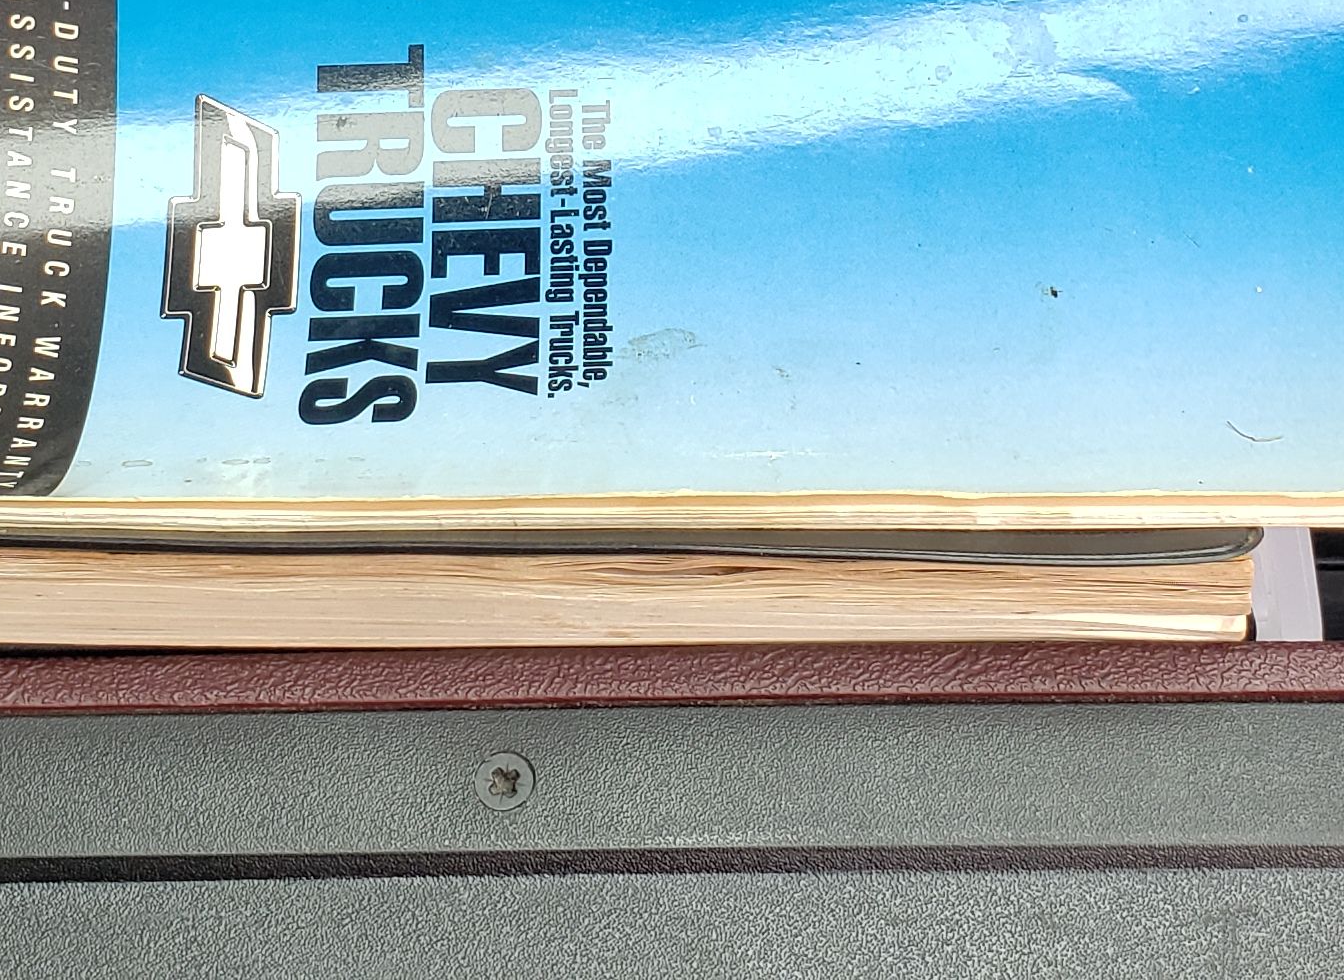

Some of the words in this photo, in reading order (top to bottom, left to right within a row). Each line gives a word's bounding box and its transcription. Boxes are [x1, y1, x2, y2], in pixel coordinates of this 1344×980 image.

[545, 89, 580, 303] Longest-Lasting
[581, 99, 611, 150] The
[582, 159, 612, 232] Most
[40, 166, 77, 308] TRUCK
[298, 44, 425, 426] TRUCKS
[425, 87, 543, 396] CHEVY
[547, 310, 580, 399] Trucks.
[577, 239, 614, 388] Dependable,
